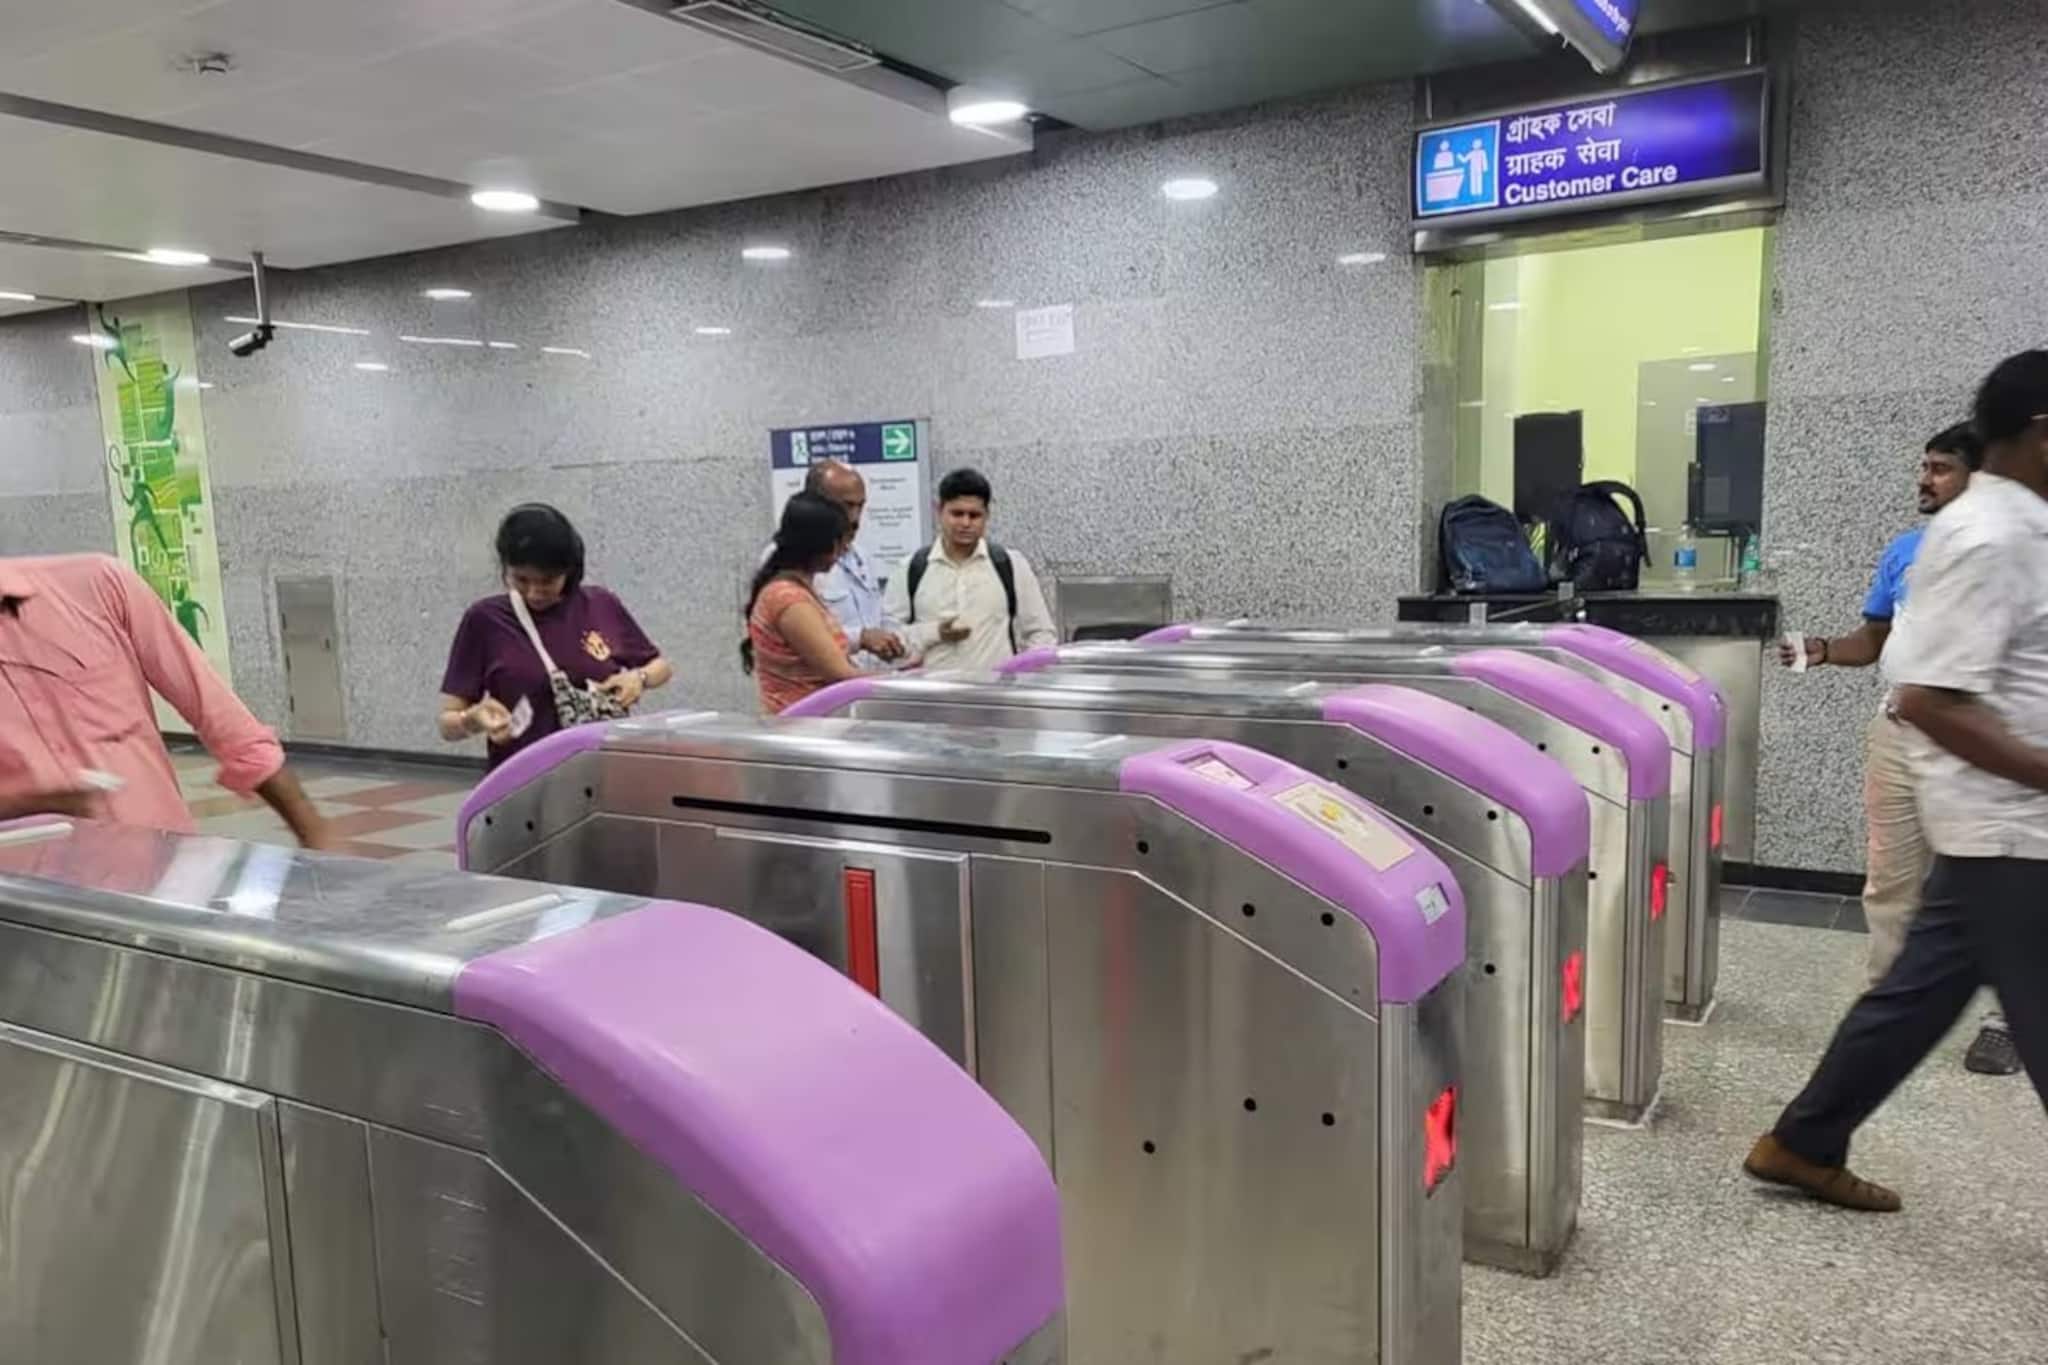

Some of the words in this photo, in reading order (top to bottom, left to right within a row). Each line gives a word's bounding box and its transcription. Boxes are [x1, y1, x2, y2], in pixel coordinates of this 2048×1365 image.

[1505, 112, 1562, 144] গ্রাহক
[1566, 103, 1617, 132] সেবা
[1505, 147, 1567, 176] ग्राहक
[1576, 136, 1623, 165] सेवा
[1505, 174, 1615, 205] Customer
[1620, 164, 1678, 188] Care
